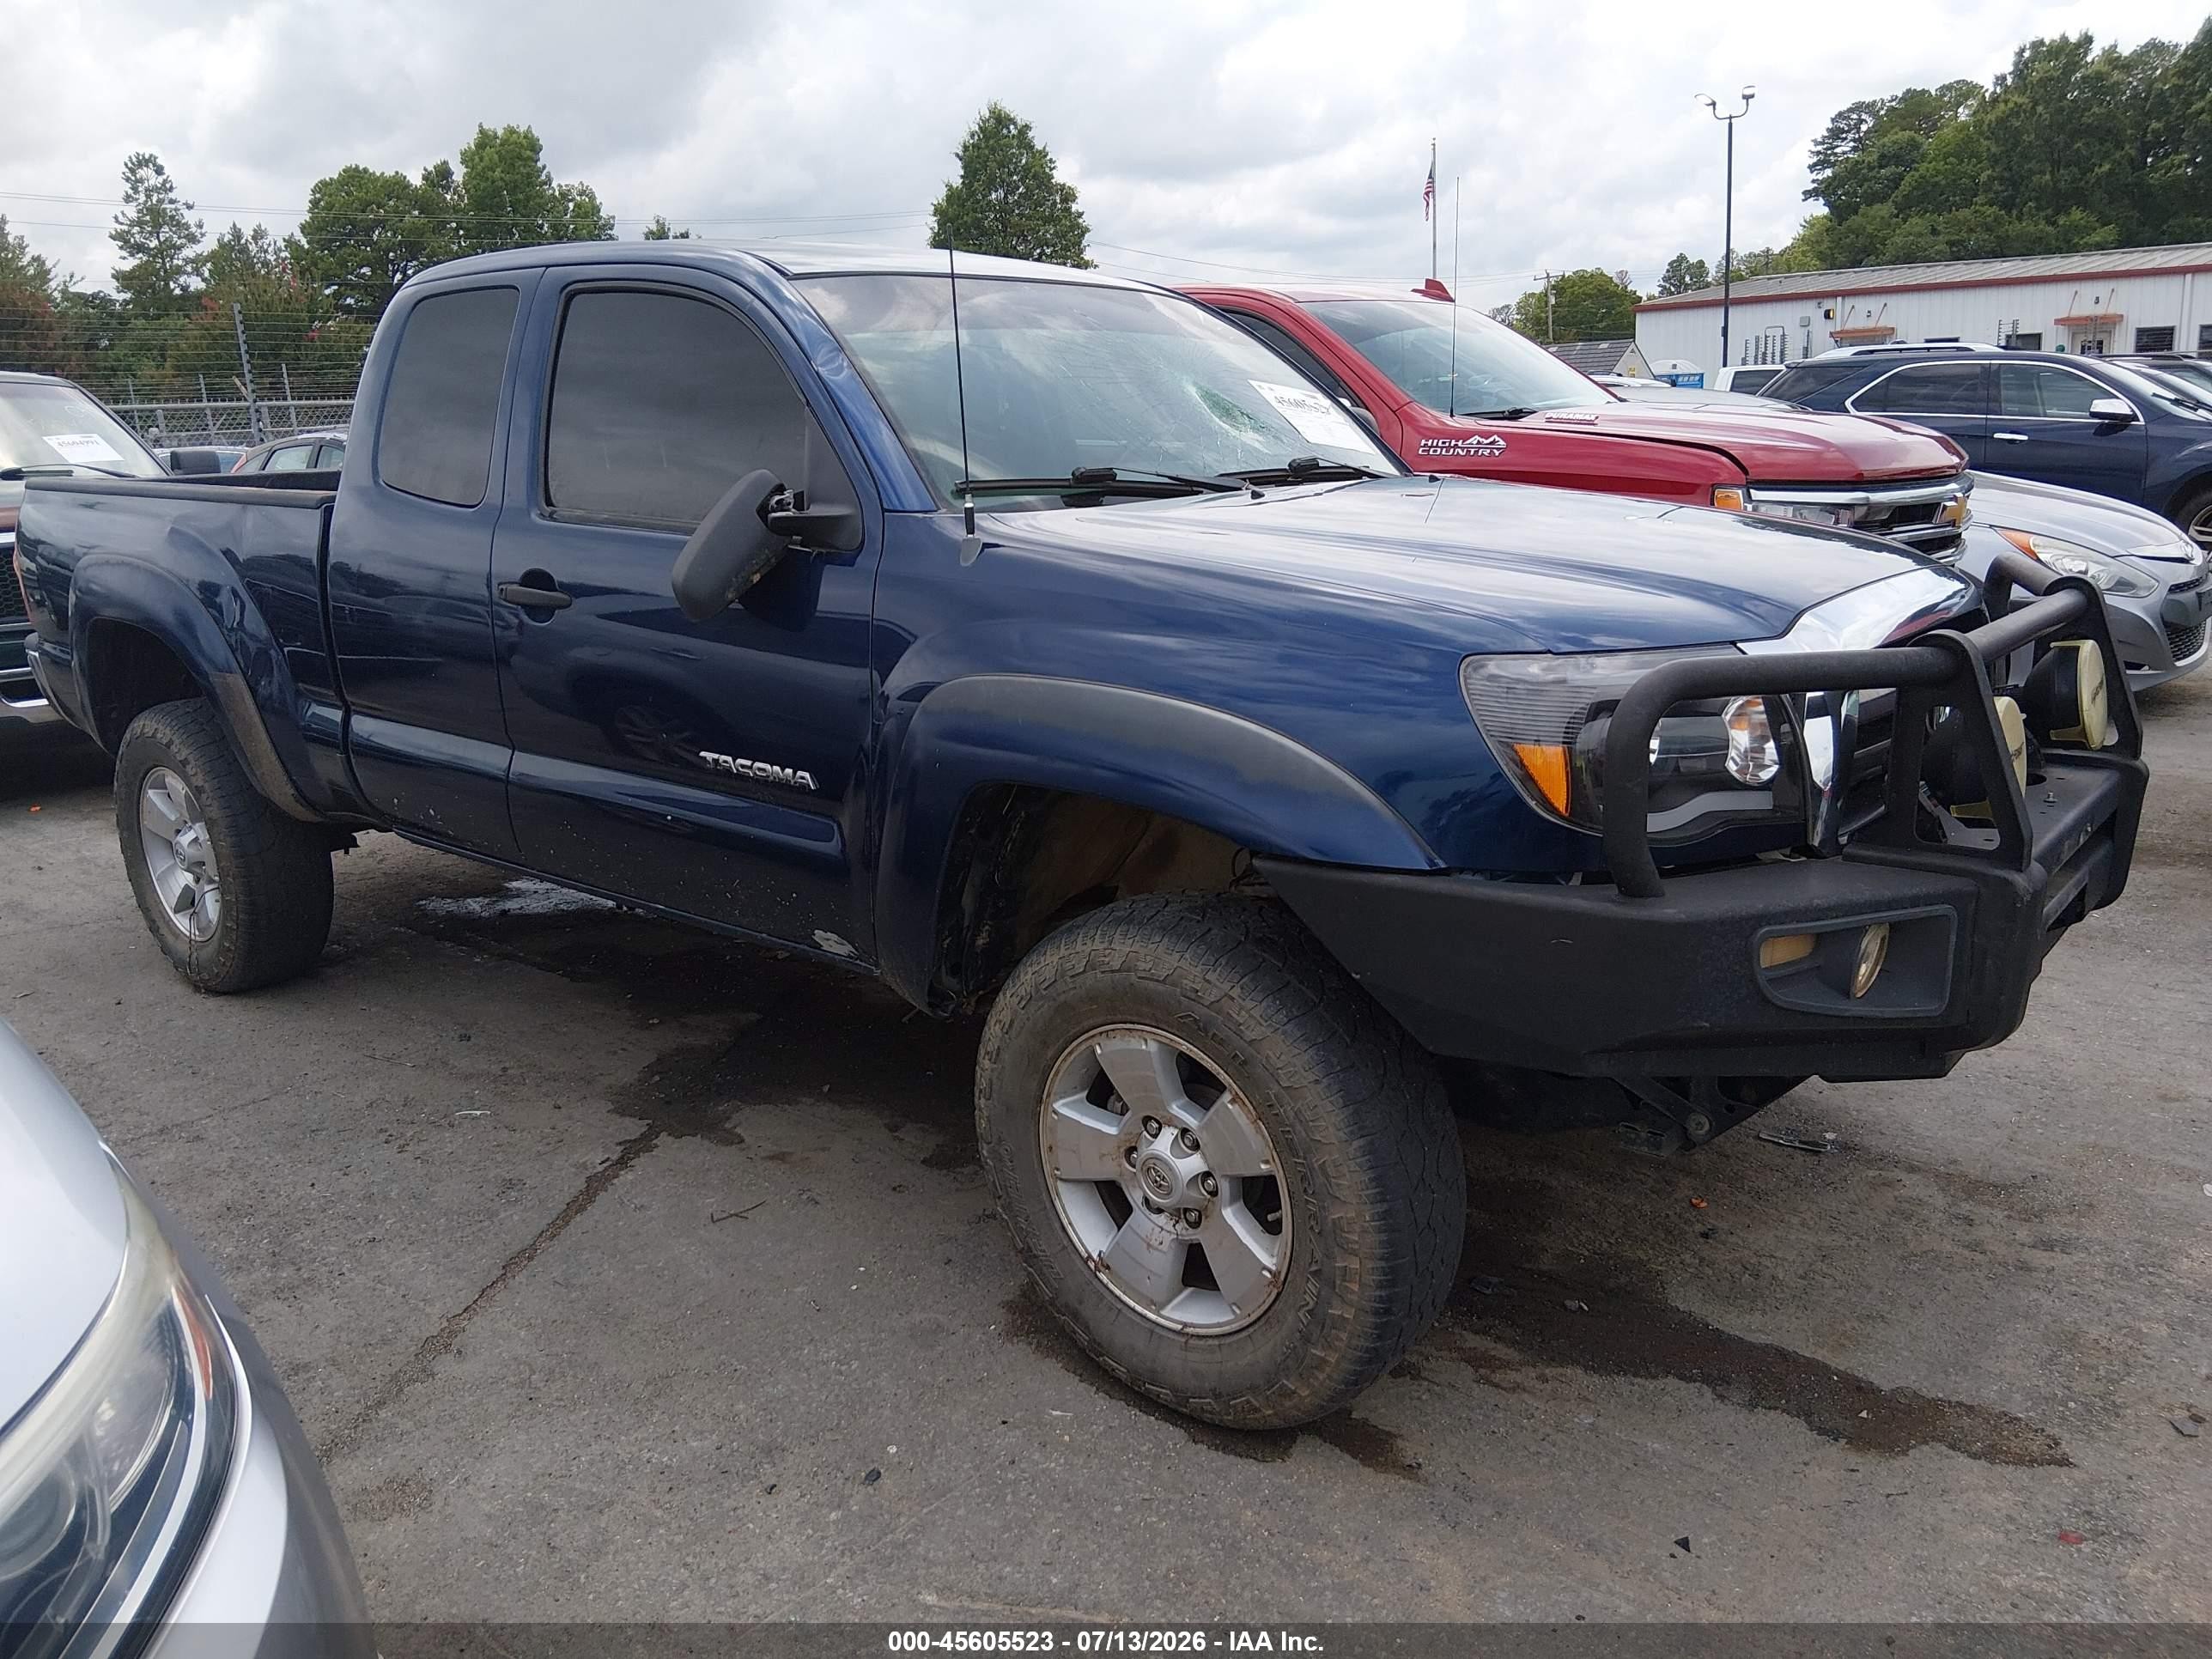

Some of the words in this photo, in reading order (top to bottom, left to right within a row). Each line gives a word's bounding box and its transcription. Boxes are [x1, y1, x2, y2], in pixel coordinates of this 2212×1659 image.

[1420, 439, 1463, 447] HIGH
[1418, 447, 1505, 457] COUNTRY
[698, 750, 818, 791] TACOMA
